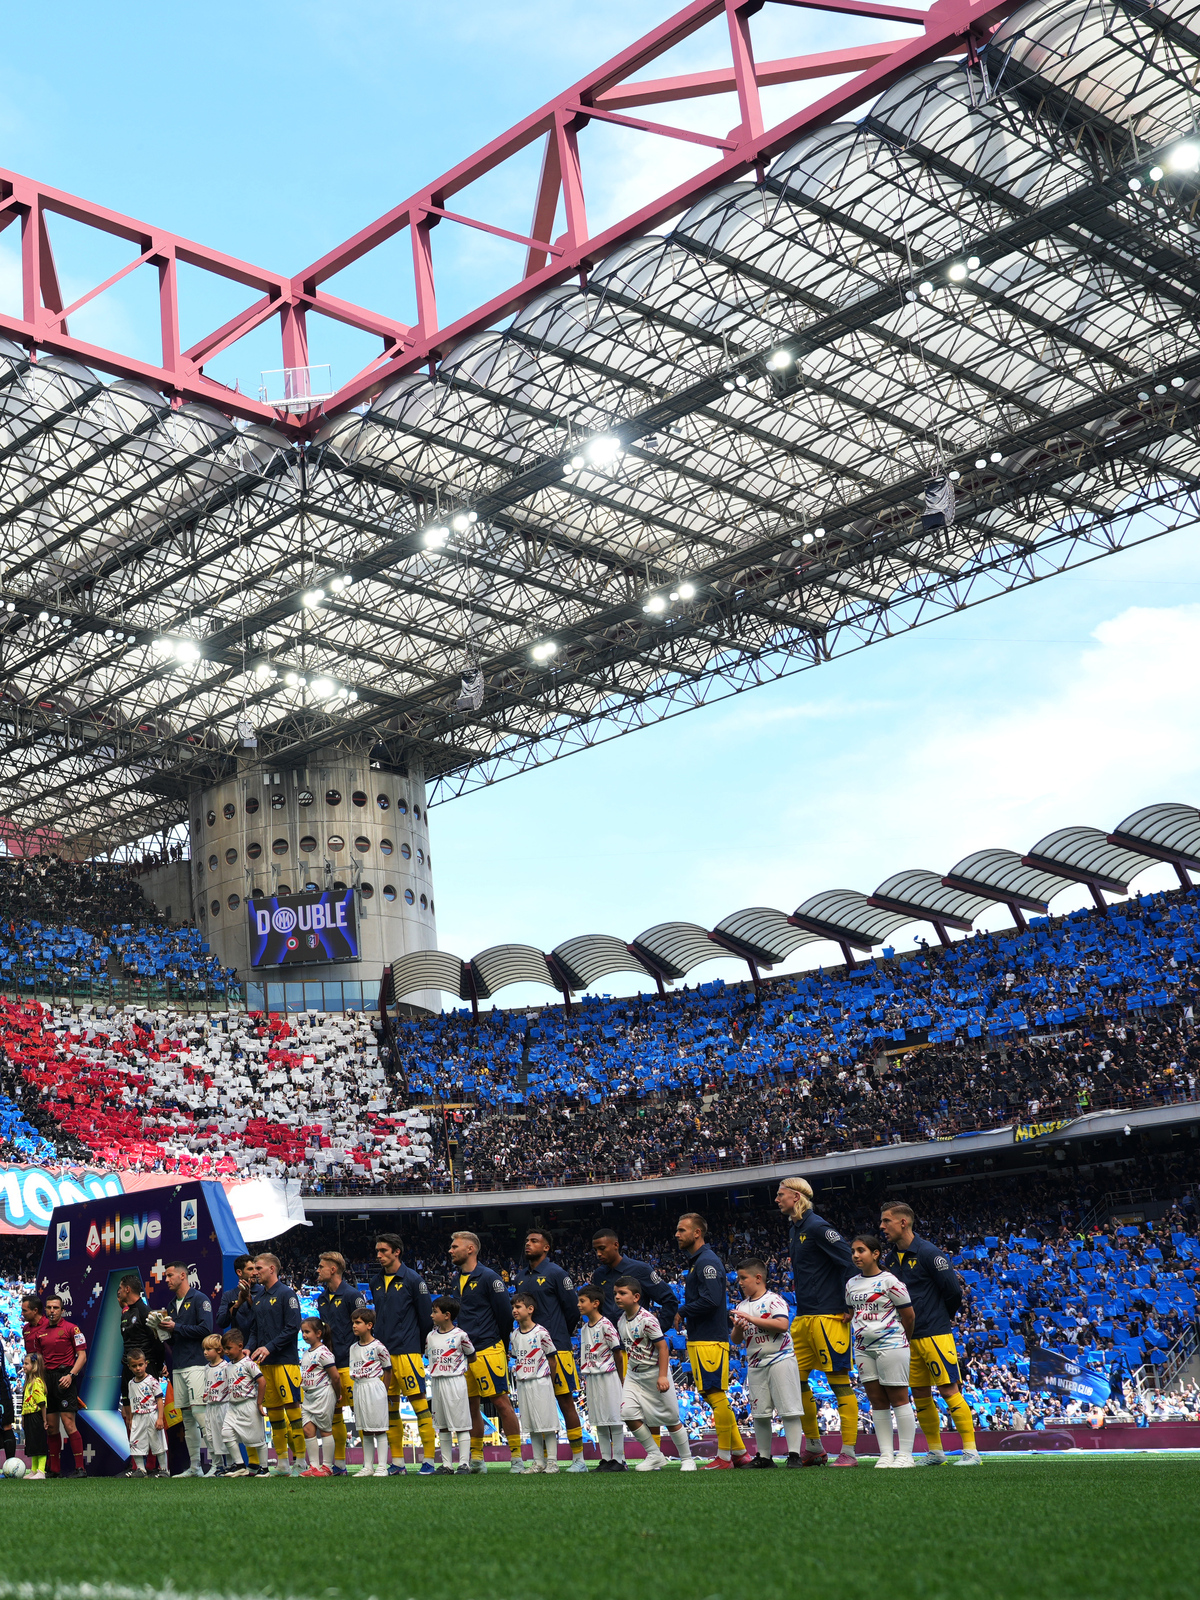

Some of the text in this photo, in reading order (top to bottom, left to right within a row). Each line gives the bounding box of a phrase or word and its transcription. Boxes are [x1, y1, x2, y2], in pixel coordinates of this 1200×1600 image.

[862, 1313, 879, 1321] OUT
[755, 1335, 770, 1344] OUT
[819, 1349, 828, 1365] 5
[402, 1375, 416, 1390] 18
[477, 1376, 489, 1391] 15
[1058, 1378, 1078, 1392] INTER
[1078, 1384, 1094, 1397] CLUB
[280, 1385, 287, 1398] 6
